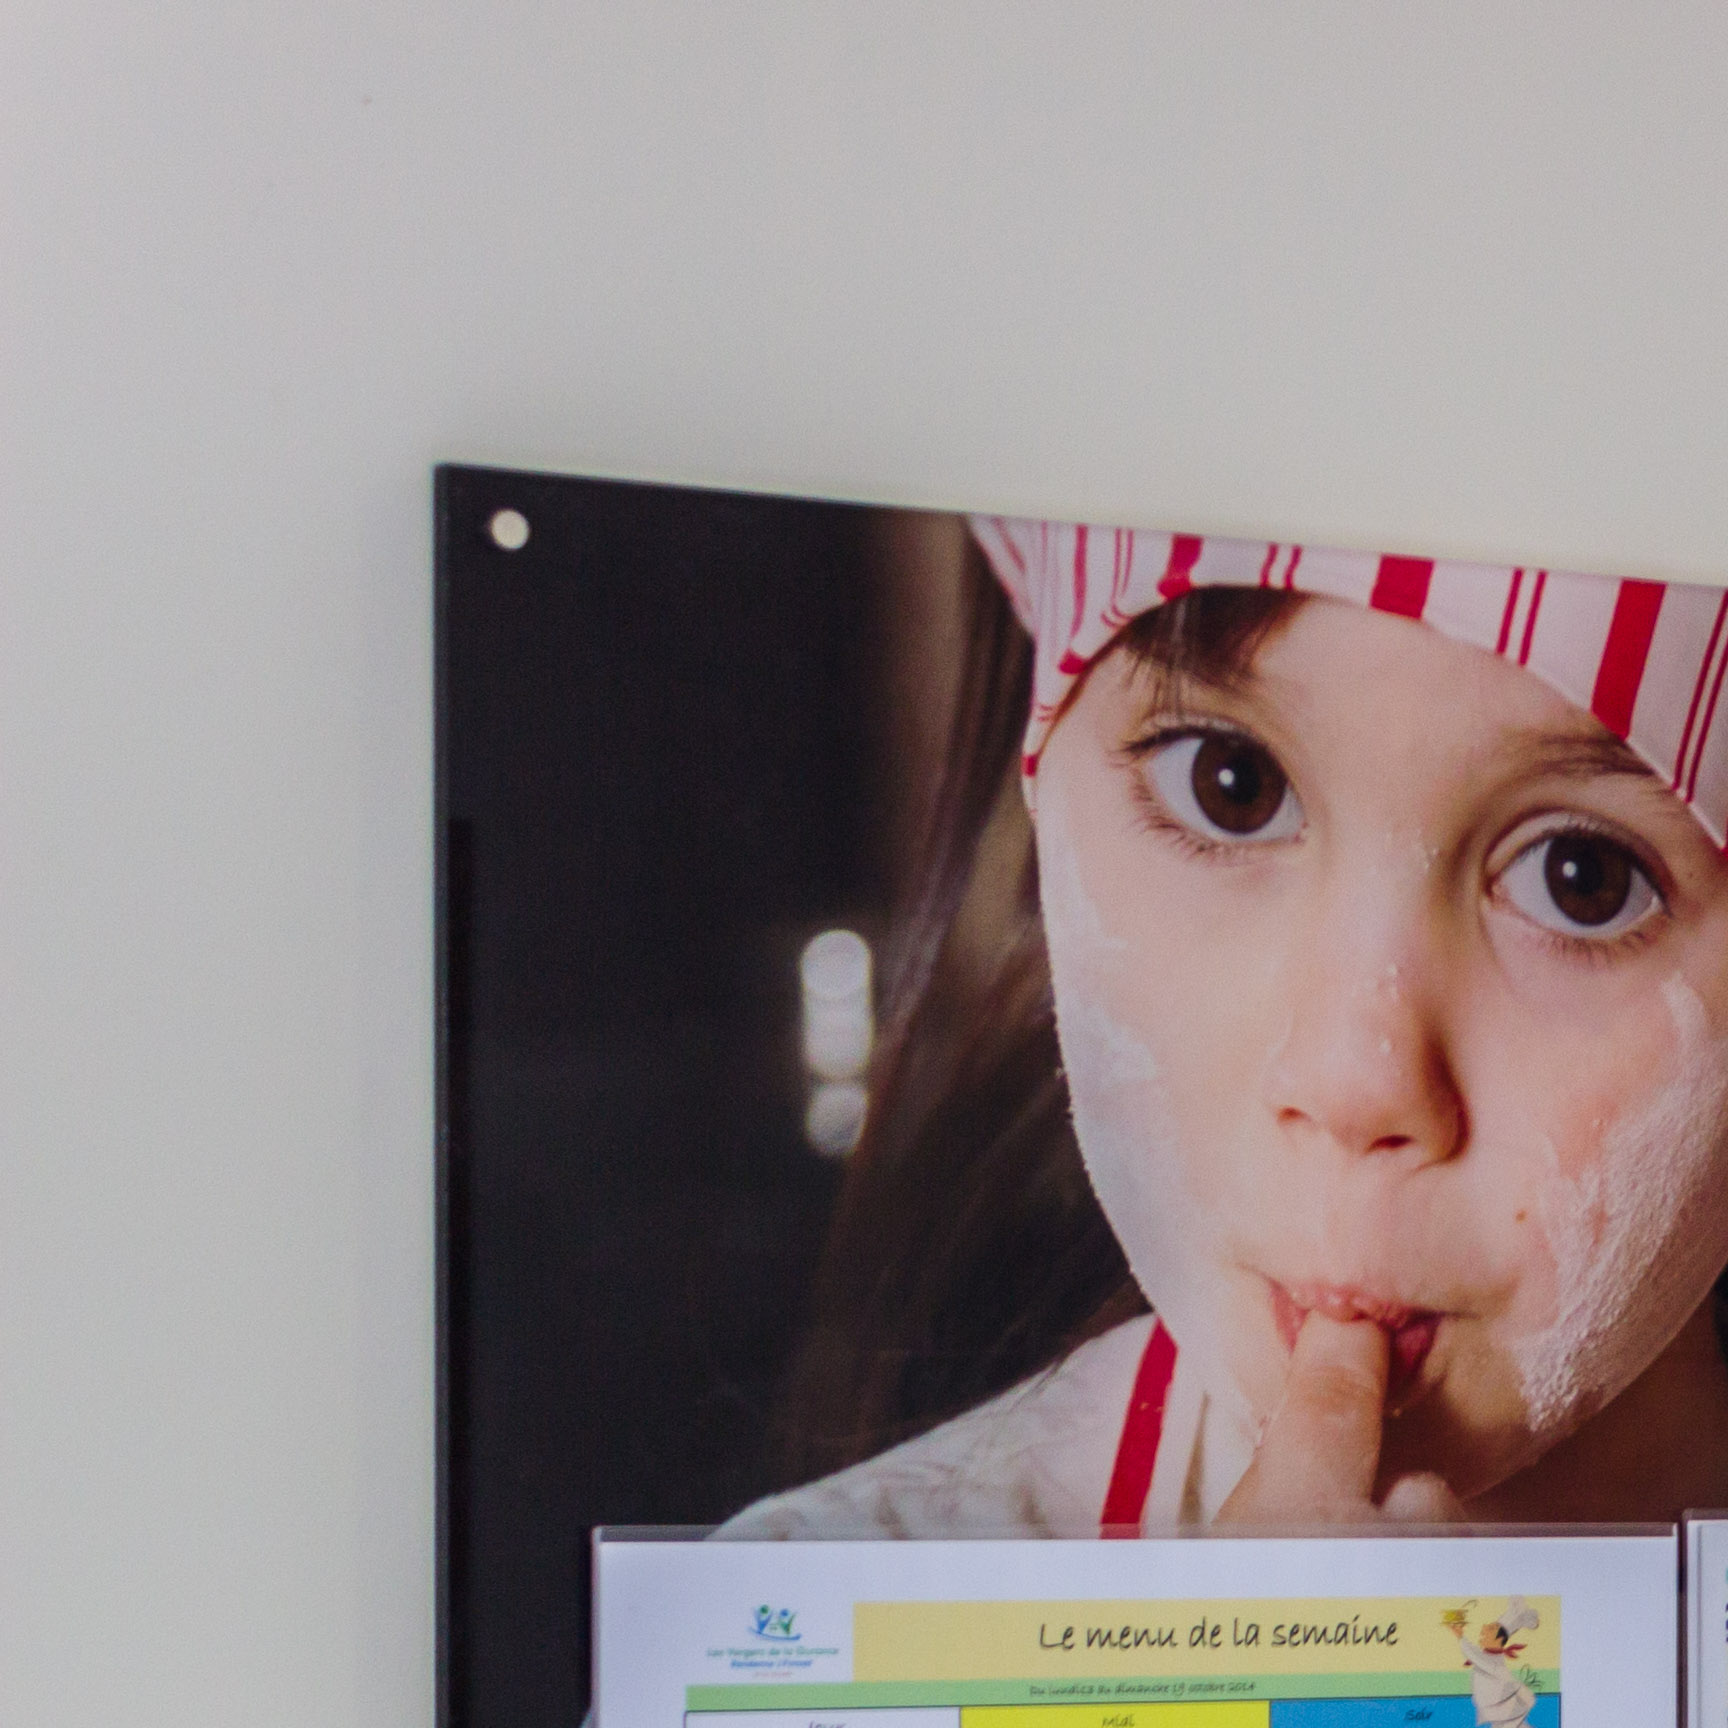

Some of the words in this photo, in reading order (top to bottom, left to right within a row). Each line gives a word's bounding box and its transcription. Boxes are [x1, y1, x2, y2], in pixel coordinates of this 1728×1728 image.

[1039, 1616, 1074, 1650] Le
[1085, 1626, 1178, 1648] menu
[1189, 1616, 1222, 1648] de
[1233, 1616, 1261, 1648] la
[1271, 1615, 1400, 1648] semaine
[1102, 1714, 1135, 1728] Midi
[1404, 1709, 1433, 1721] Soir
